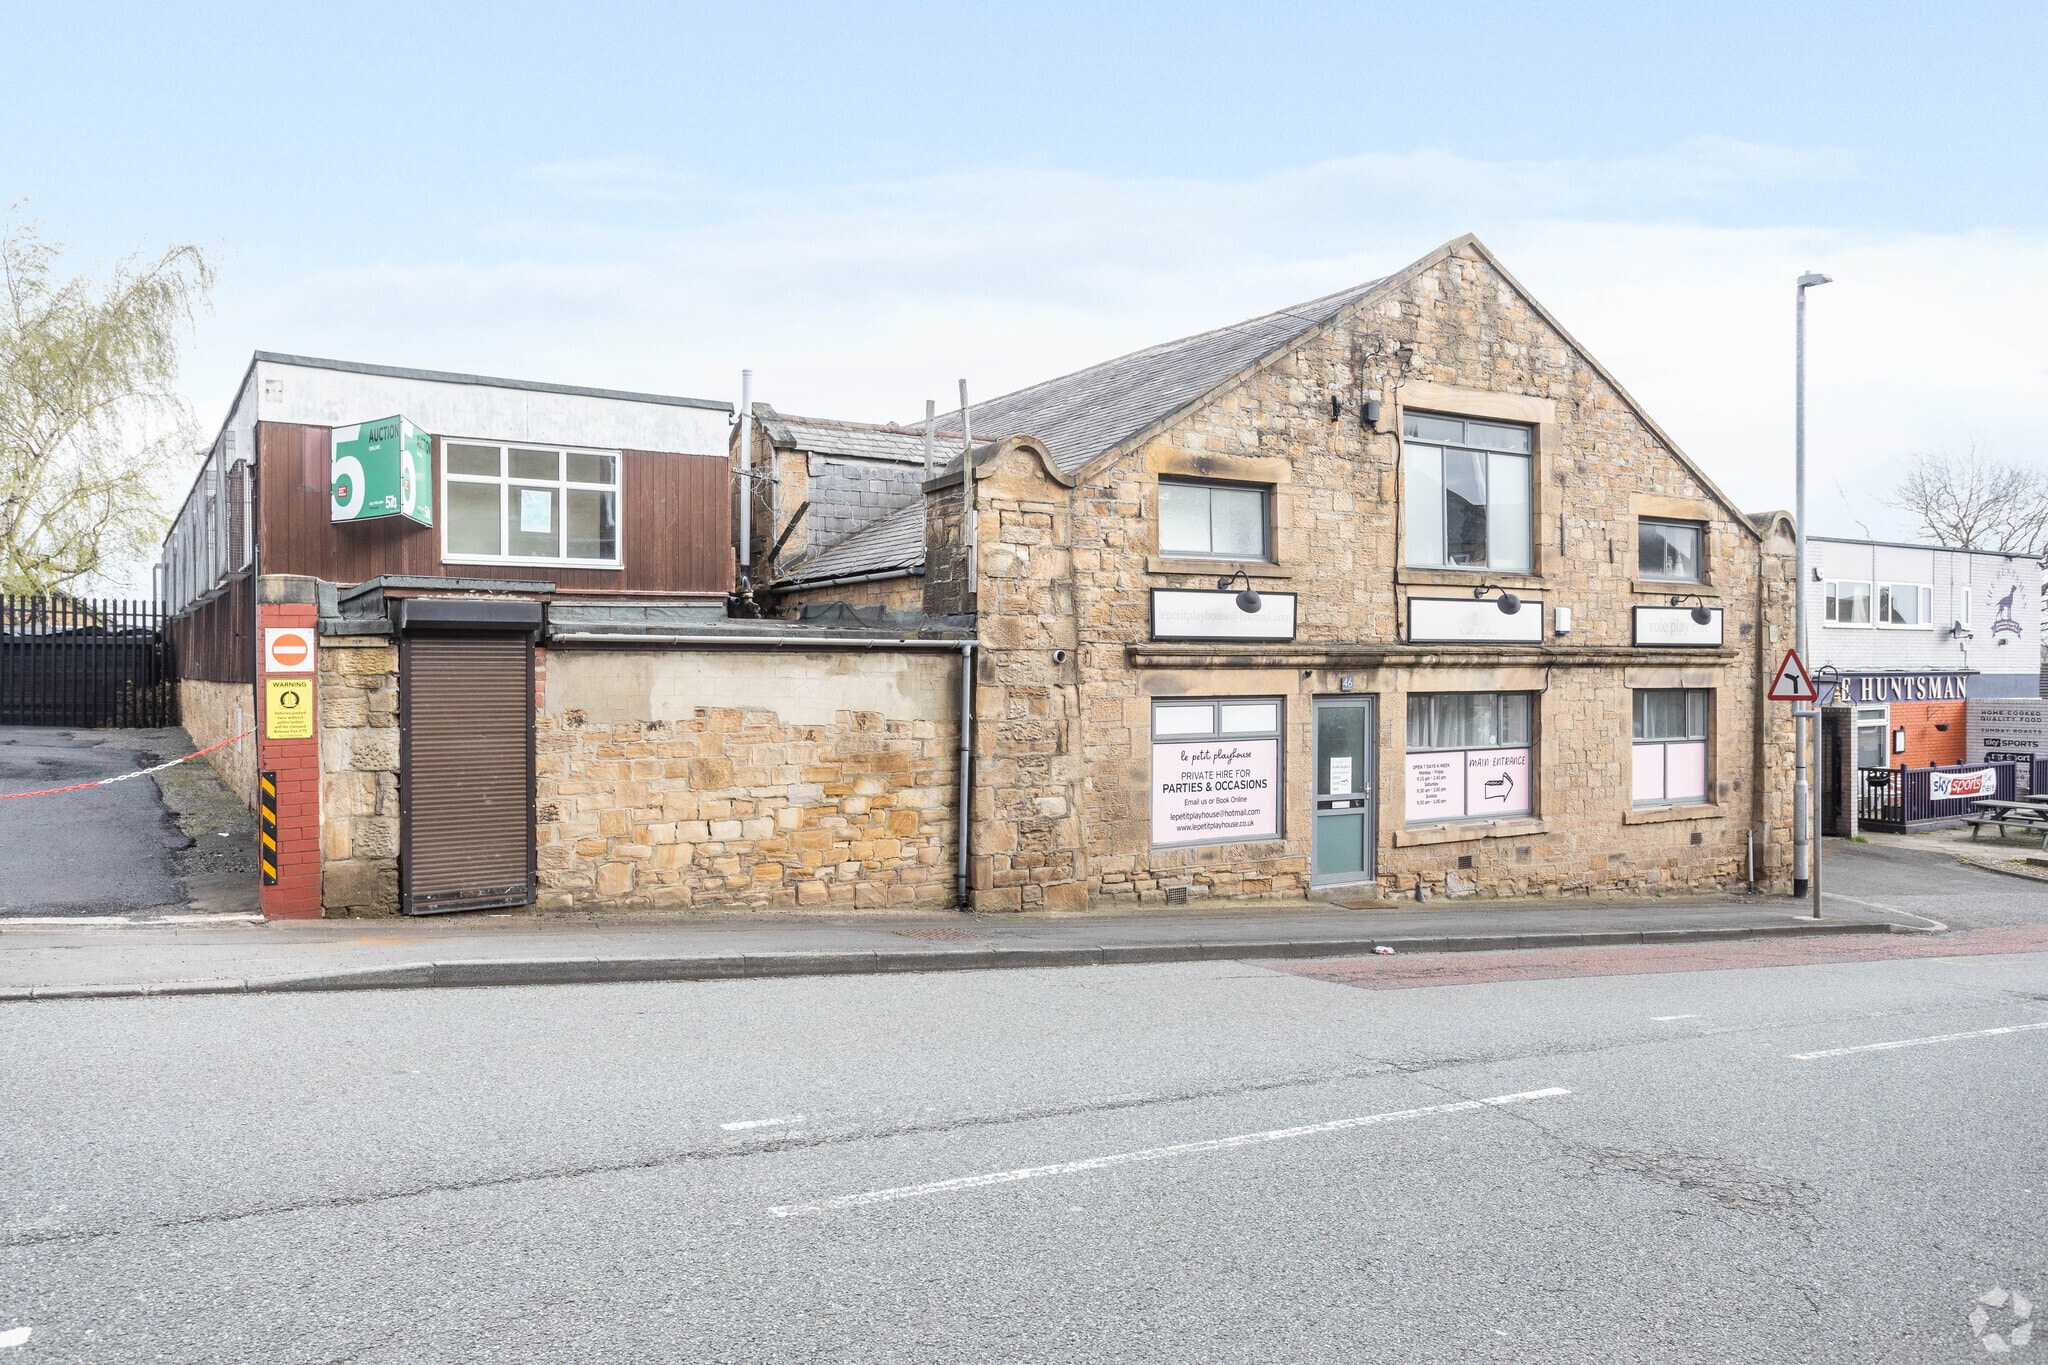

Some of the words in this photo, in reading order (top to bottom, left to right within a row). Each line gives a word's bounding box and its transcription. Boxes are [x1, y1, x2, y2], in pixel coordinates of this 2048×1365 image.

[368, 424, 400, 443] AUCTION
[1342, 677, 1353, 688] 46
[1861, 676, 1967, 701] HUNTSMAN
[1180, 750, 1189, 761] le
[1191, 749, 1211, 766] petit
[1213, 748, 1252, 765] playhouse
[1181, 771, 1214, 781] PRIVATE
[1215, 770, 1233, 779] HIRE
[1235, 769, 1251, 778] FOR
[1162, 782, 1203, 793] PARTIES
[1205, 782, 1212, 792] &
[1215, 779, 1268, 791] OCCASIONS
[1933, 777, 1950, 795] sky
[1952, 779, 1980, 793] sports
[1169, 808, 1261, 821] lepetitplayhouse@hotmail.com
[1176, 819, 1255, 832] www.lepetitplayhouse.co.uk
